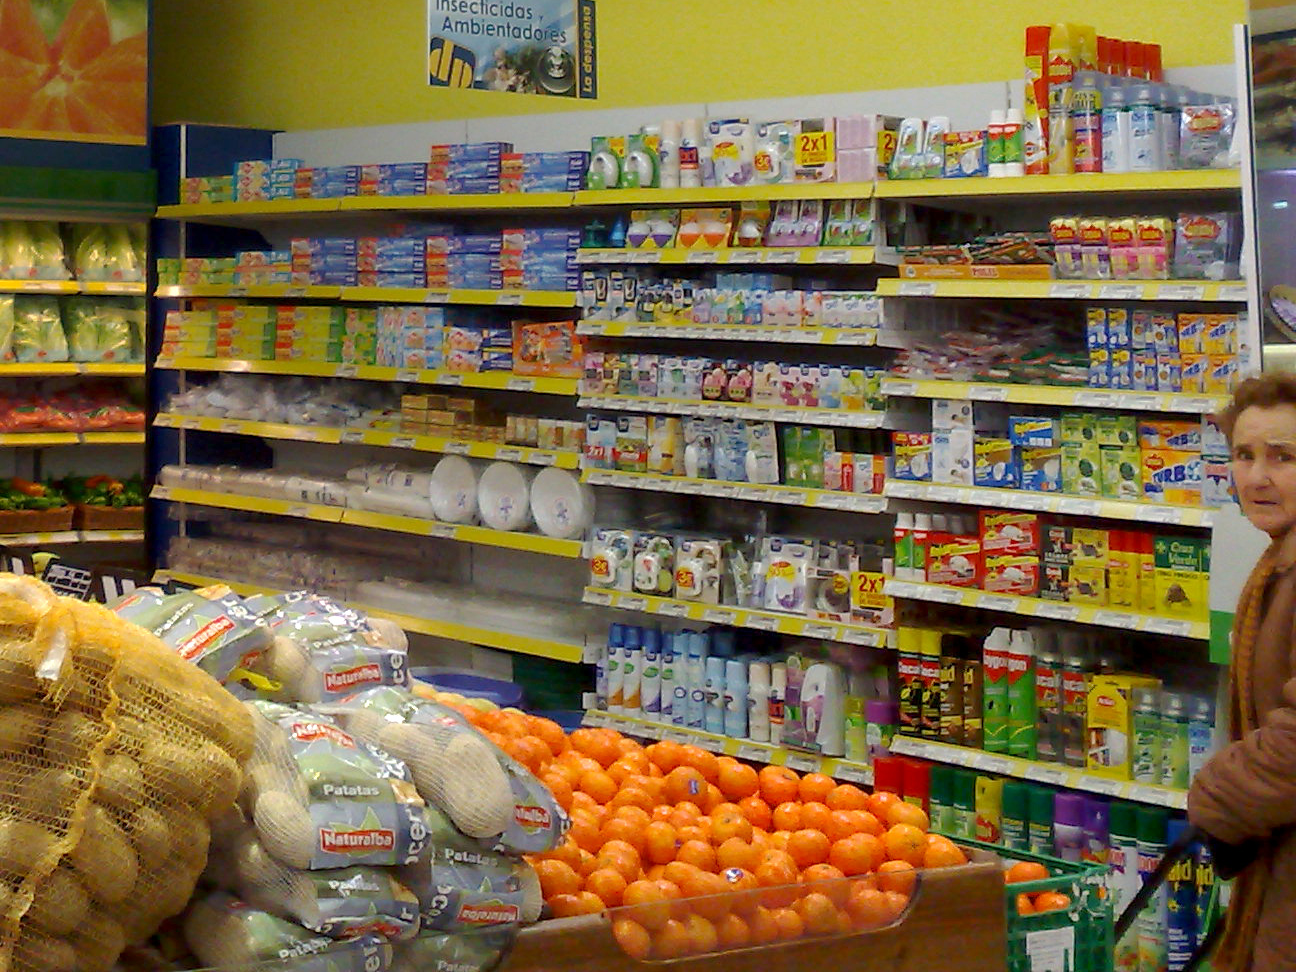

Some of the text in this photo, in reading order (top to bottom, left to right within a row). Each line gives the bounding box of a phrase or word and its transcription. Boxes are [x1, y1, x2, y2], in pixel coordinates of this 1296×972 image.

[441, 16, 568, 45] Ambientadores
[582, 5, 595, 94] La despensa
[800, 134, 828, 152] 2x1
[322, 783, 381, 797] Patatas
[324, 831, 393, 846] Naturalba
[444, 848, 498, 866] Patatas
